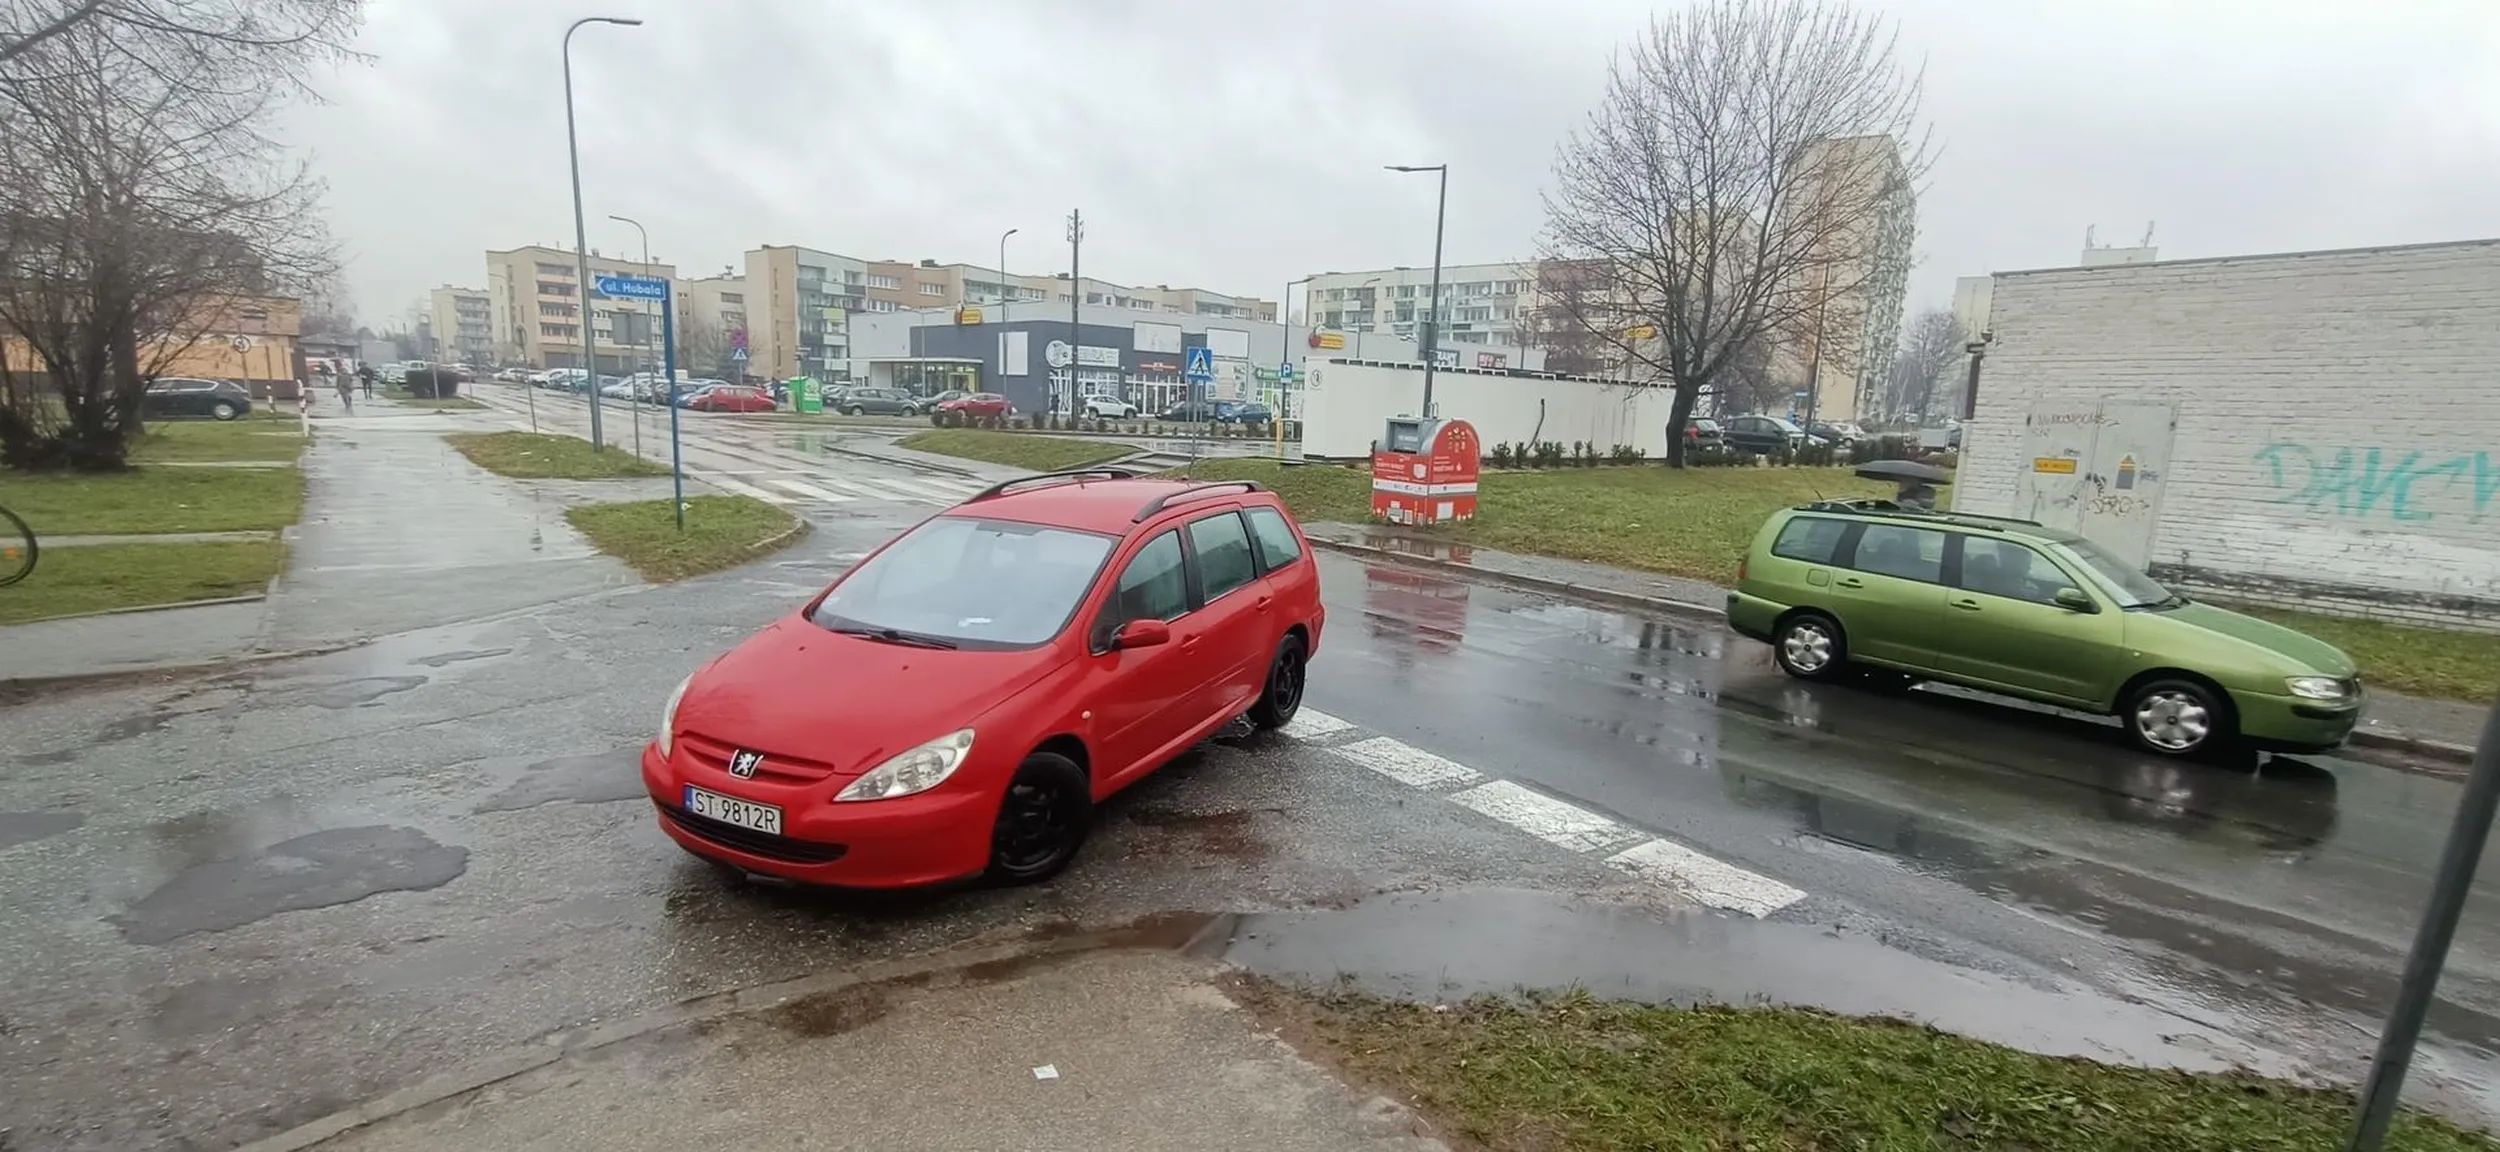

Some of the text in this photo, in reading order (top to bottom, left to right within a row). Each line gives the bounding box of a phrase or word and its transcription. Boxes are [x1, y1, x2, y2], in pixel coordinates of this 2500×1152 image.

[606, 281, 662, 296] ul. Hubala
[695, 792, 776, 832] ST 9812R
